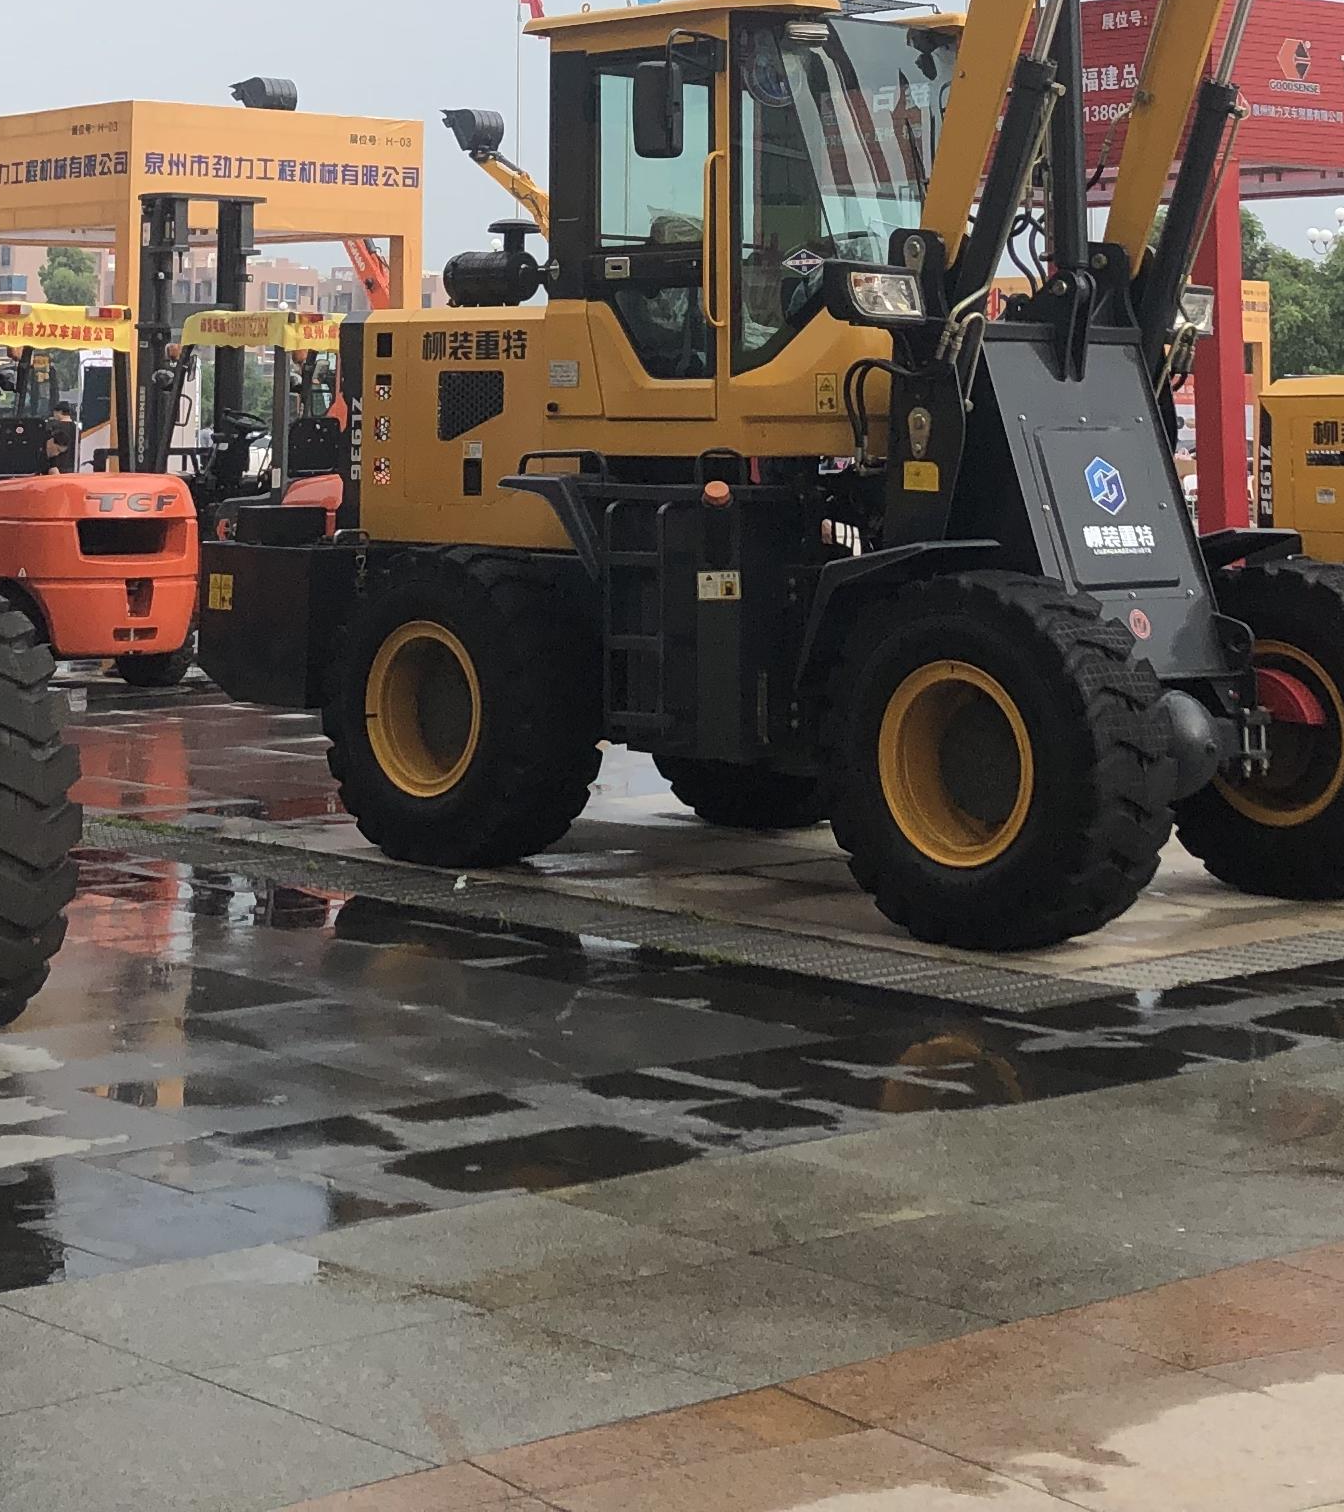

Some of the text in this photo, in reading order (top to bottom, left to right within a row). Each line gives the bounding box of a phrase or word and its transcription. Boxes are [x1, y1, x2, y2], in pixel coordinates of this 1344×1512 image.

[1269, 80, 1321, 94] GOODSENSE
[385, 136, 413, 148] H-03
[144, 152, 421, 189] 泉州市劲力工程机械有限公司
[422, 329, 528, 361] 柳装重特
[350, 397, 363, 480] ZL936
[1260, 445, 1273, 515] ZL932
[86, 492, 178, 512] TCF
[1082, 524, 1155, 548] 柳装重特
